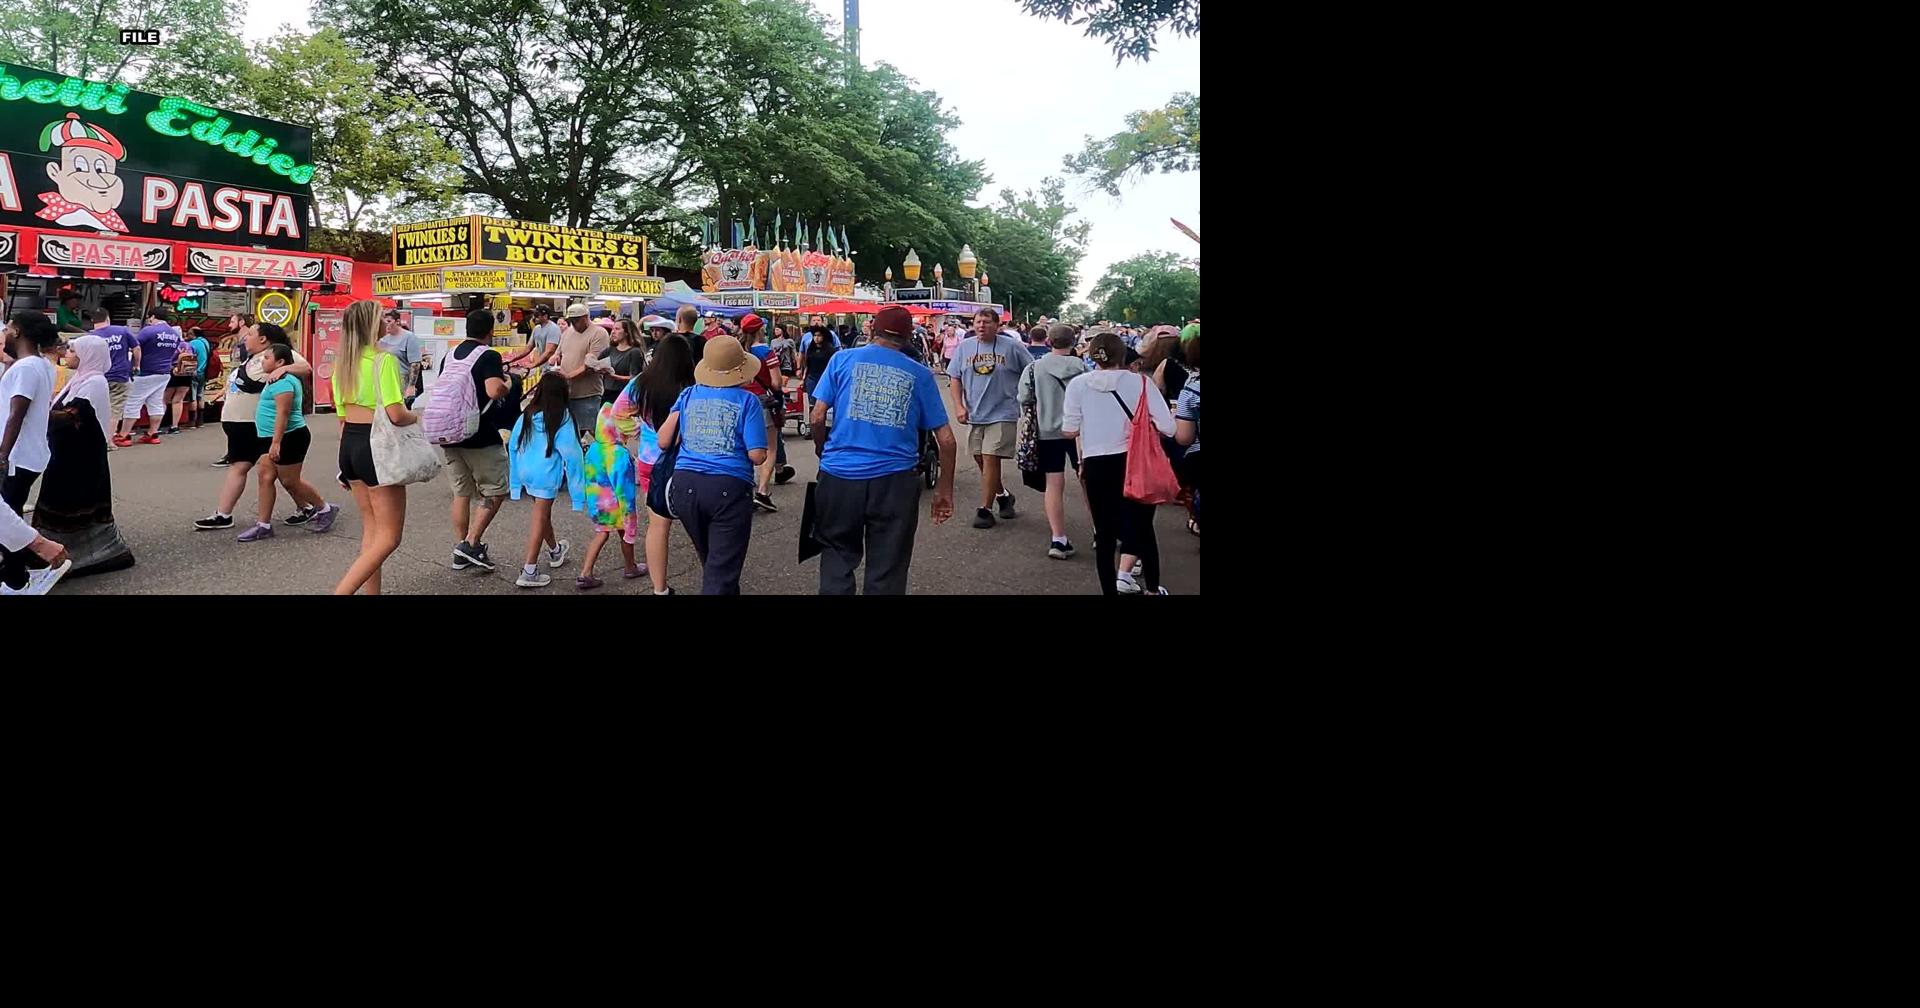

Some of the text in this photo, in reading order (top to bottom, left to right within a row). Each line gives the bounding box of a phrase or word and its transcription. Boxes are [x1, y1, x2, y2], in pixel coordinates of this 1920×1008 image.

[145, 96, 315, 185] Eddies
[142, 176, 301, 239] PASTA
[398, 225, 468, 249] TWINKIES &
[483, 216, 642, 243] DEEP FRIED BATTER DIPPED
[484, 225, 639, 256] TWINKIES &
[70, 241, 145, 267] PASTA
[405, 243, 469, 265] BUCKEYES
[505, 244, 640, 271] BUCKEYES
[217, 255, 300, 278] PIZZA
[515, 271, 539, 281] DEEP
[513, 280, 541, 289] FRIED
[540, 273, 590, 291] TWINKIES
[600, 284, 622, 293] FRIED
[601, 276, 620, 285] DEEP
[621, 278, 662, 294] BUCKEYES
[156, 332, 179, 342] xfinity
[863, 382, 900, 397] Carlson
[864, 390, 897, 407] Family
